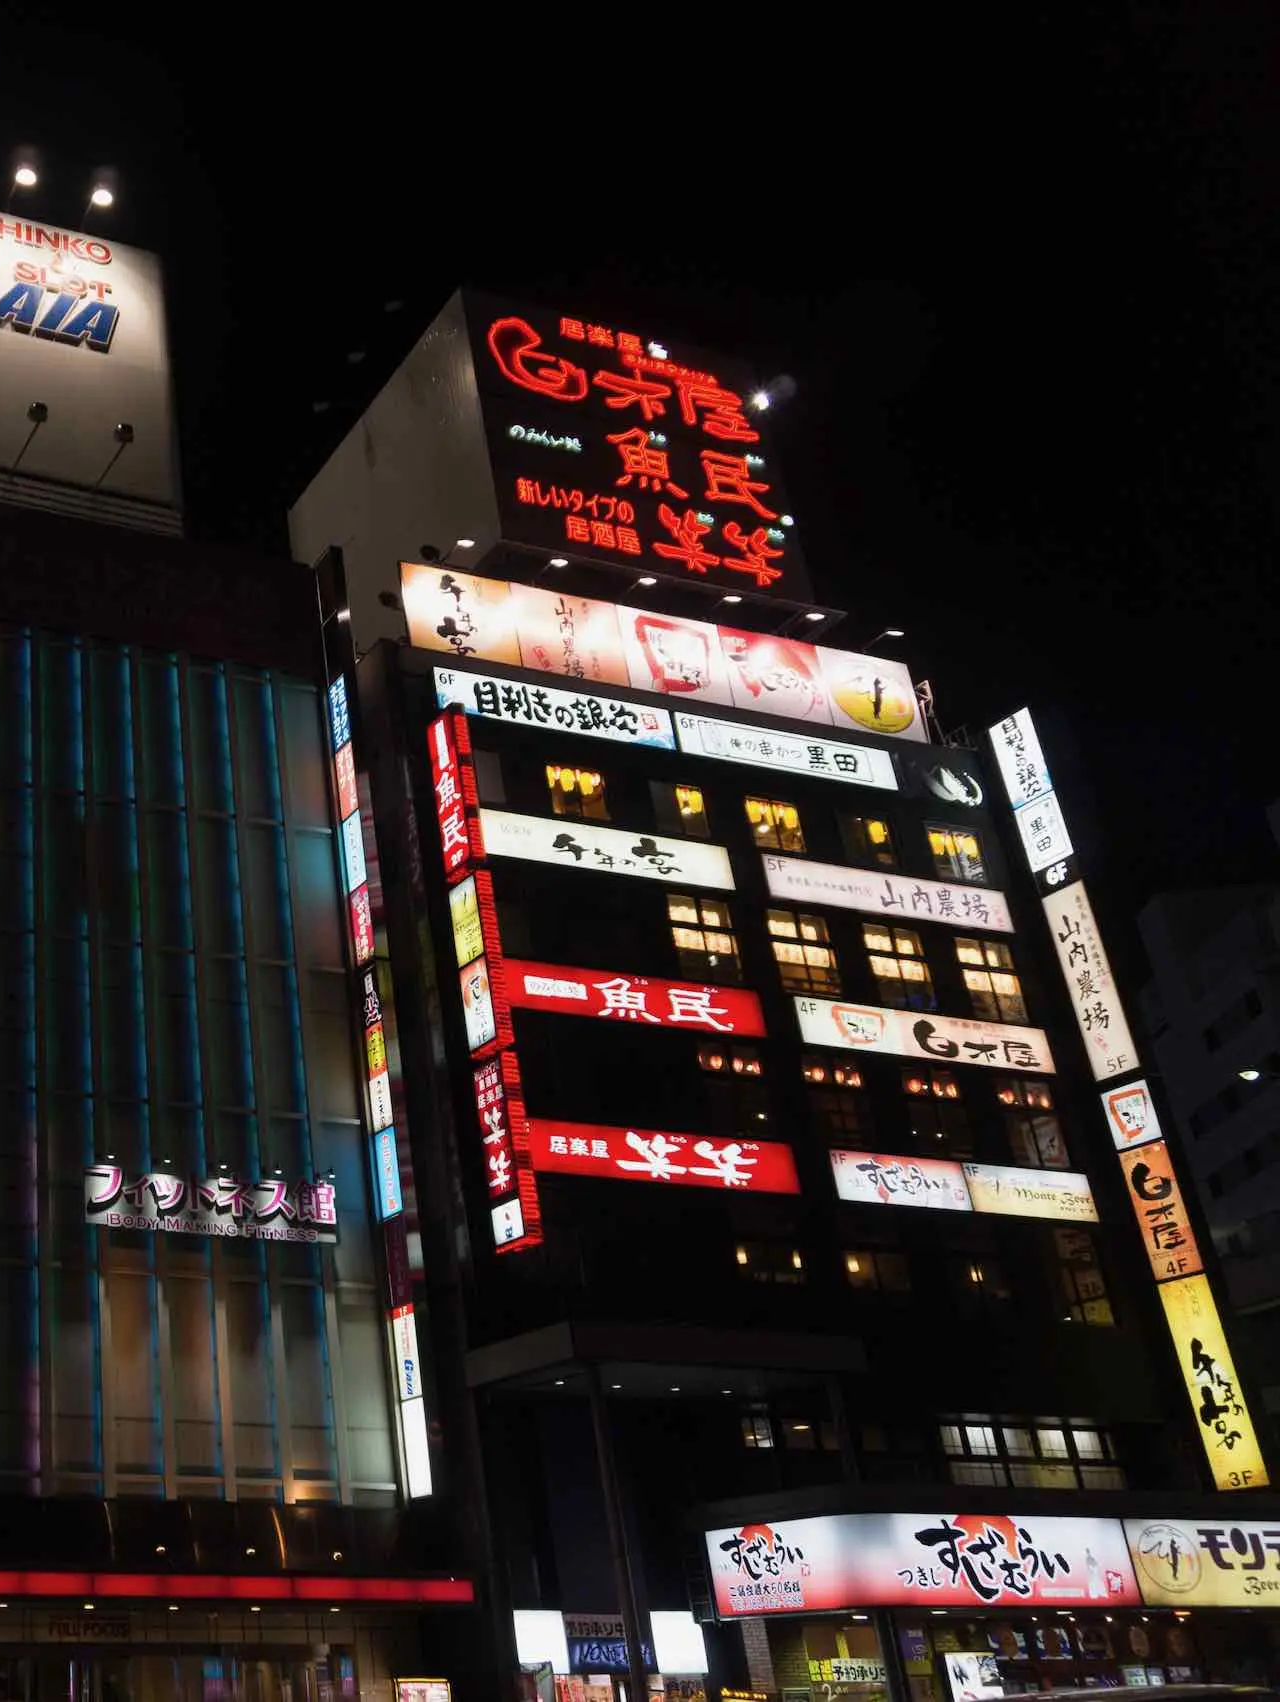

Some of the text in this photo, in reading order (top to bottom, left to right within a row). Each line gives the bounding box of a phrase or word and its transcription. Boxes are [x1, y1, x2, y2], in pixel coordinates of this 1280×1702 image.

[15, 261, 112, 300] SLOT
[606, 427, 780, 520] 魚民
[516, 477, 635, 524] 新しいタイプの
[439, 672, 638, 736] 6F 目利きの銀次
[807, 745, 859, 773] 黒田
[435, 770, 469, 852] 魚民
[1030, 815, 1053, 853] 黒田
[450, 849, 465, 867] 2F
[767, 858, 788, 872] 5F
[1046, 861, 1069, 886] 6F
[879, 879, 991, 925] 山内農場
[1058, 914, 1111, 1034] 山内農場
[592, 977, 734, 1032] 魚民
[800, 1001, 817, 1016] 4F
[1107, 1054, 1128, 1074] 5F
[549, 1135, 610, 1159] 居楽屋
[831, 1152, 847, 1165] 1F
[965, 1164, 980, 1177] 1F
[85, 1164, 337, 1226] フィットネス館
[106, 1212, 318, 1242] BODY MAKING FITNESS
[1166, 1258, 1189, 1275] 4F
[1229, 1471, 1253, 1488] 3F
[897, 1567, 942, 1588] つきじ
